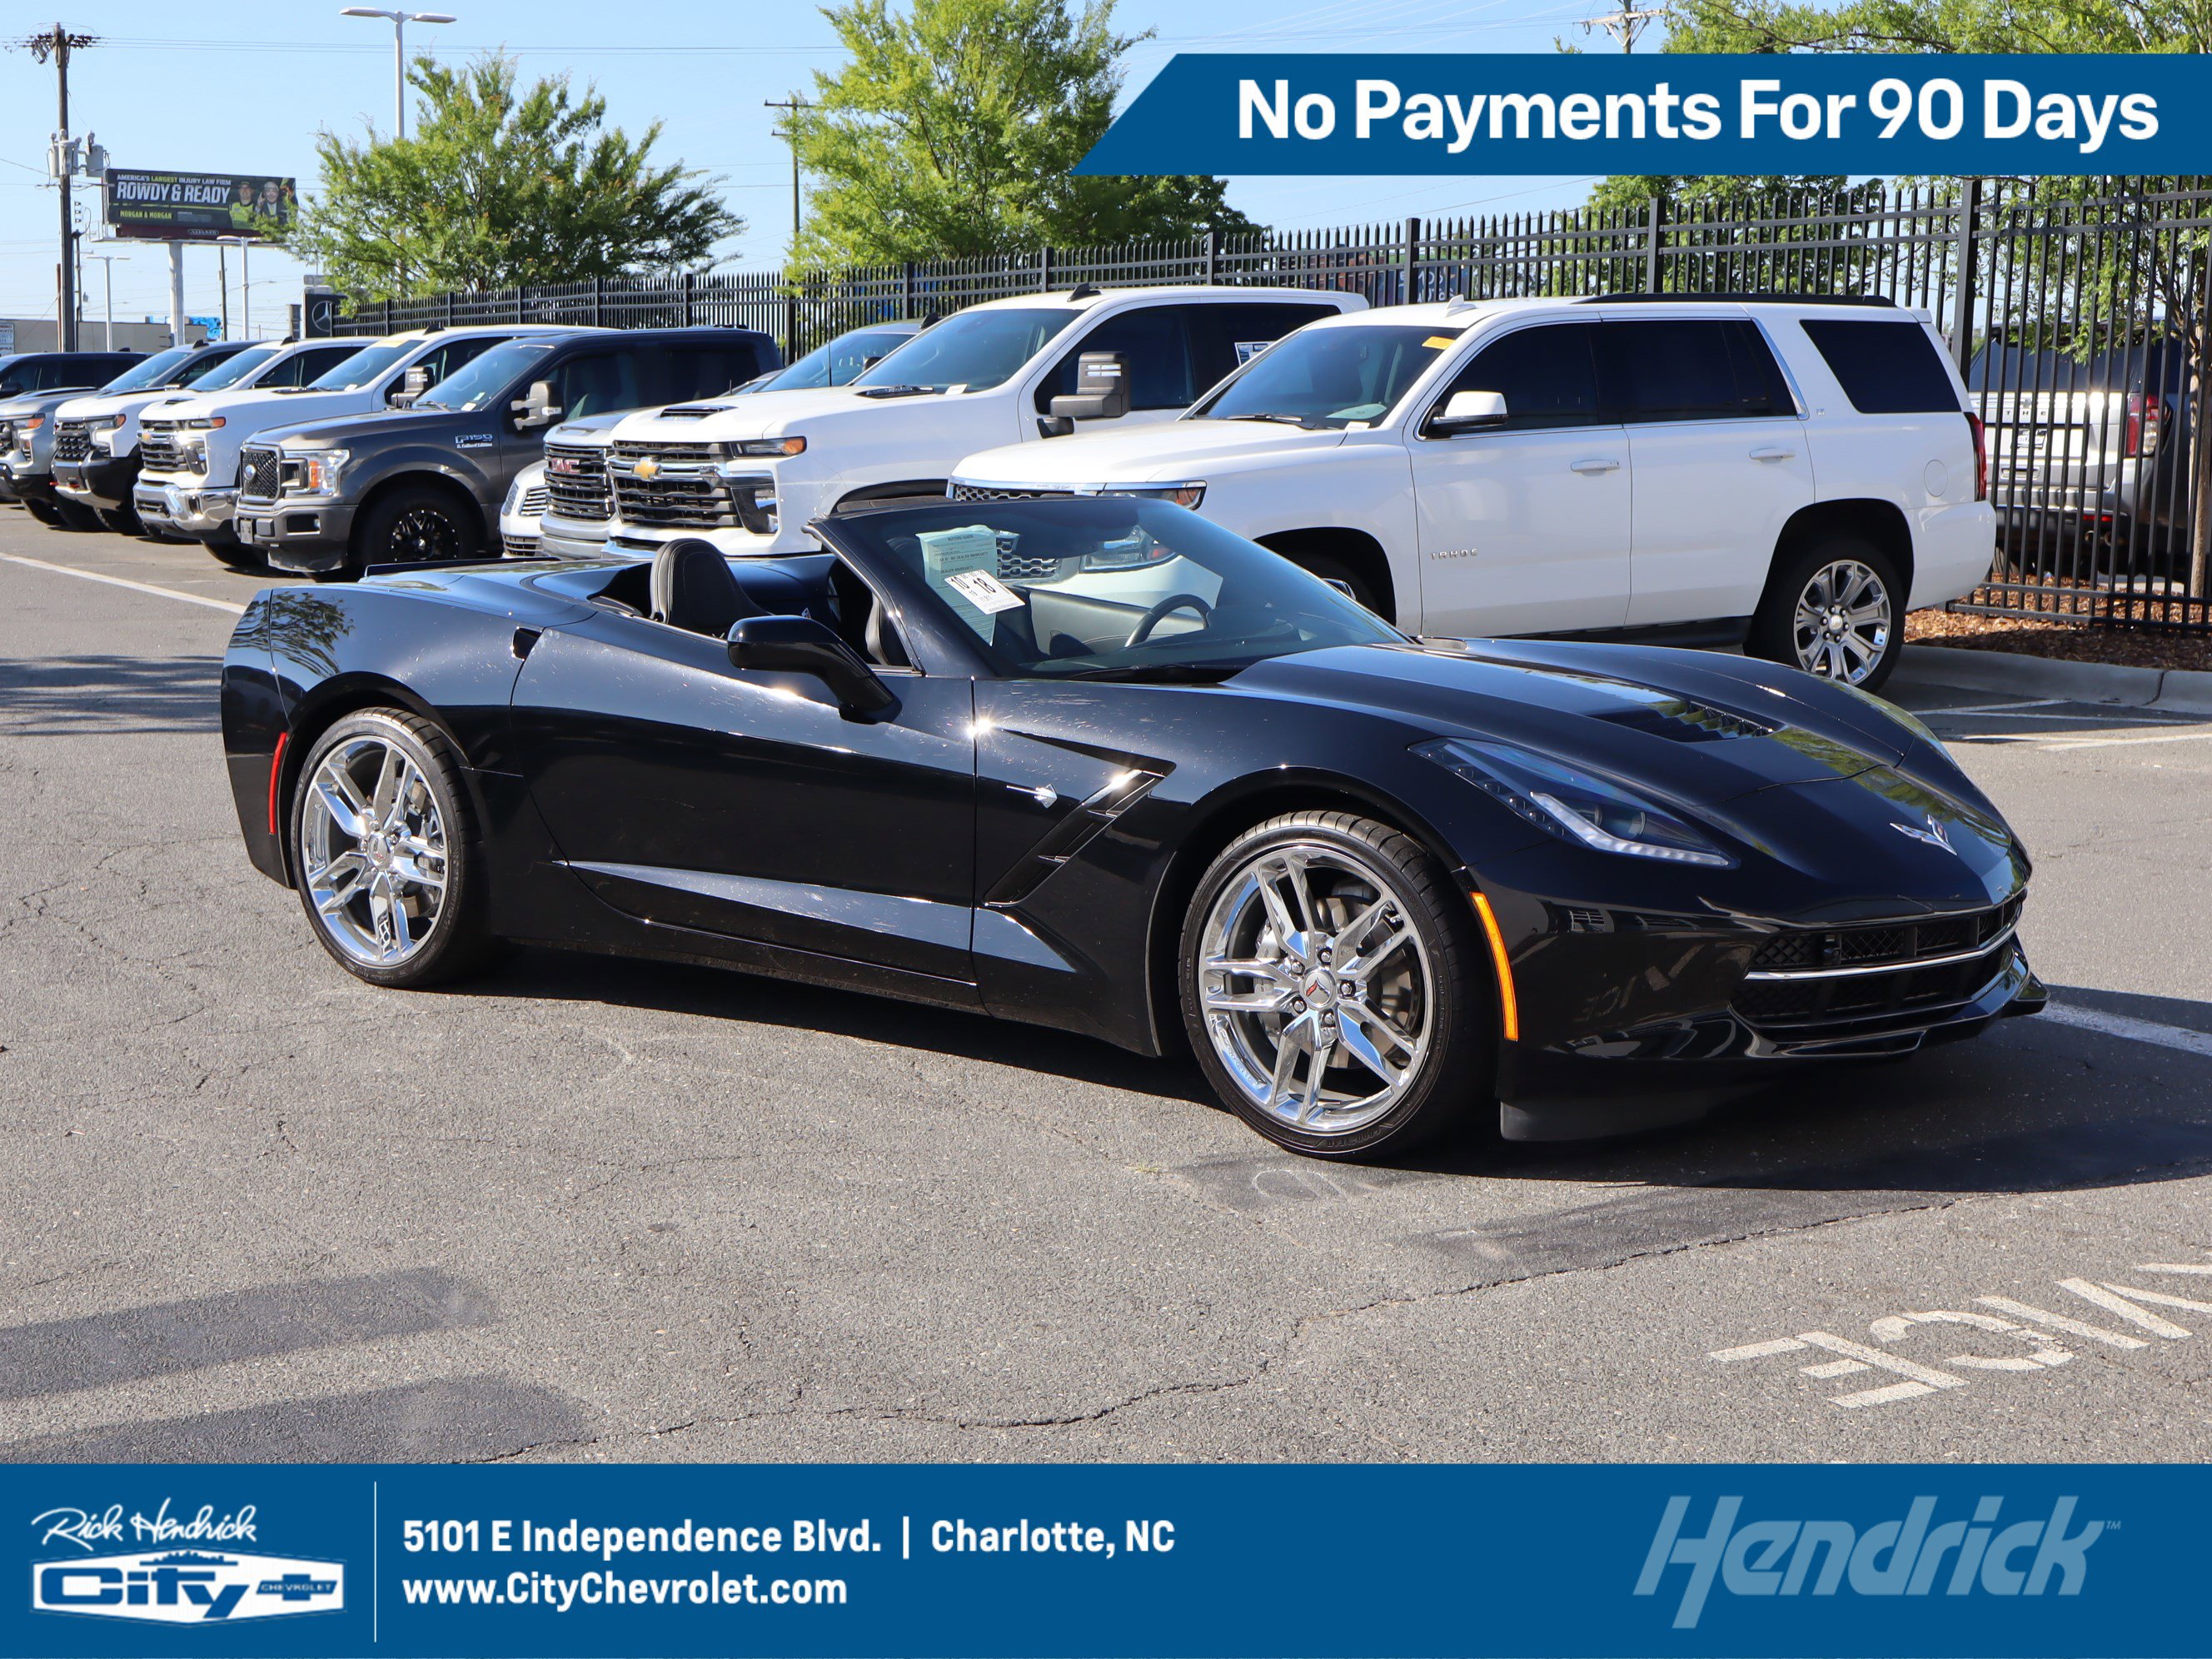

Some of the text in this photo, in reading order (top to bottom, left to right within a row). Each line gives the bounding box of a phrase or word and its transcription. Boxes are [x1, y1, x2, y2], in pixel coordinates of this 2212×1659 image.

[117, 181, 231, 204] ROWDY & READY
[120, 210, 143, 218] MORGAN
[1431, 549, 1478, 560] TAHOE
[950, 576, 996, 594] 10 18
